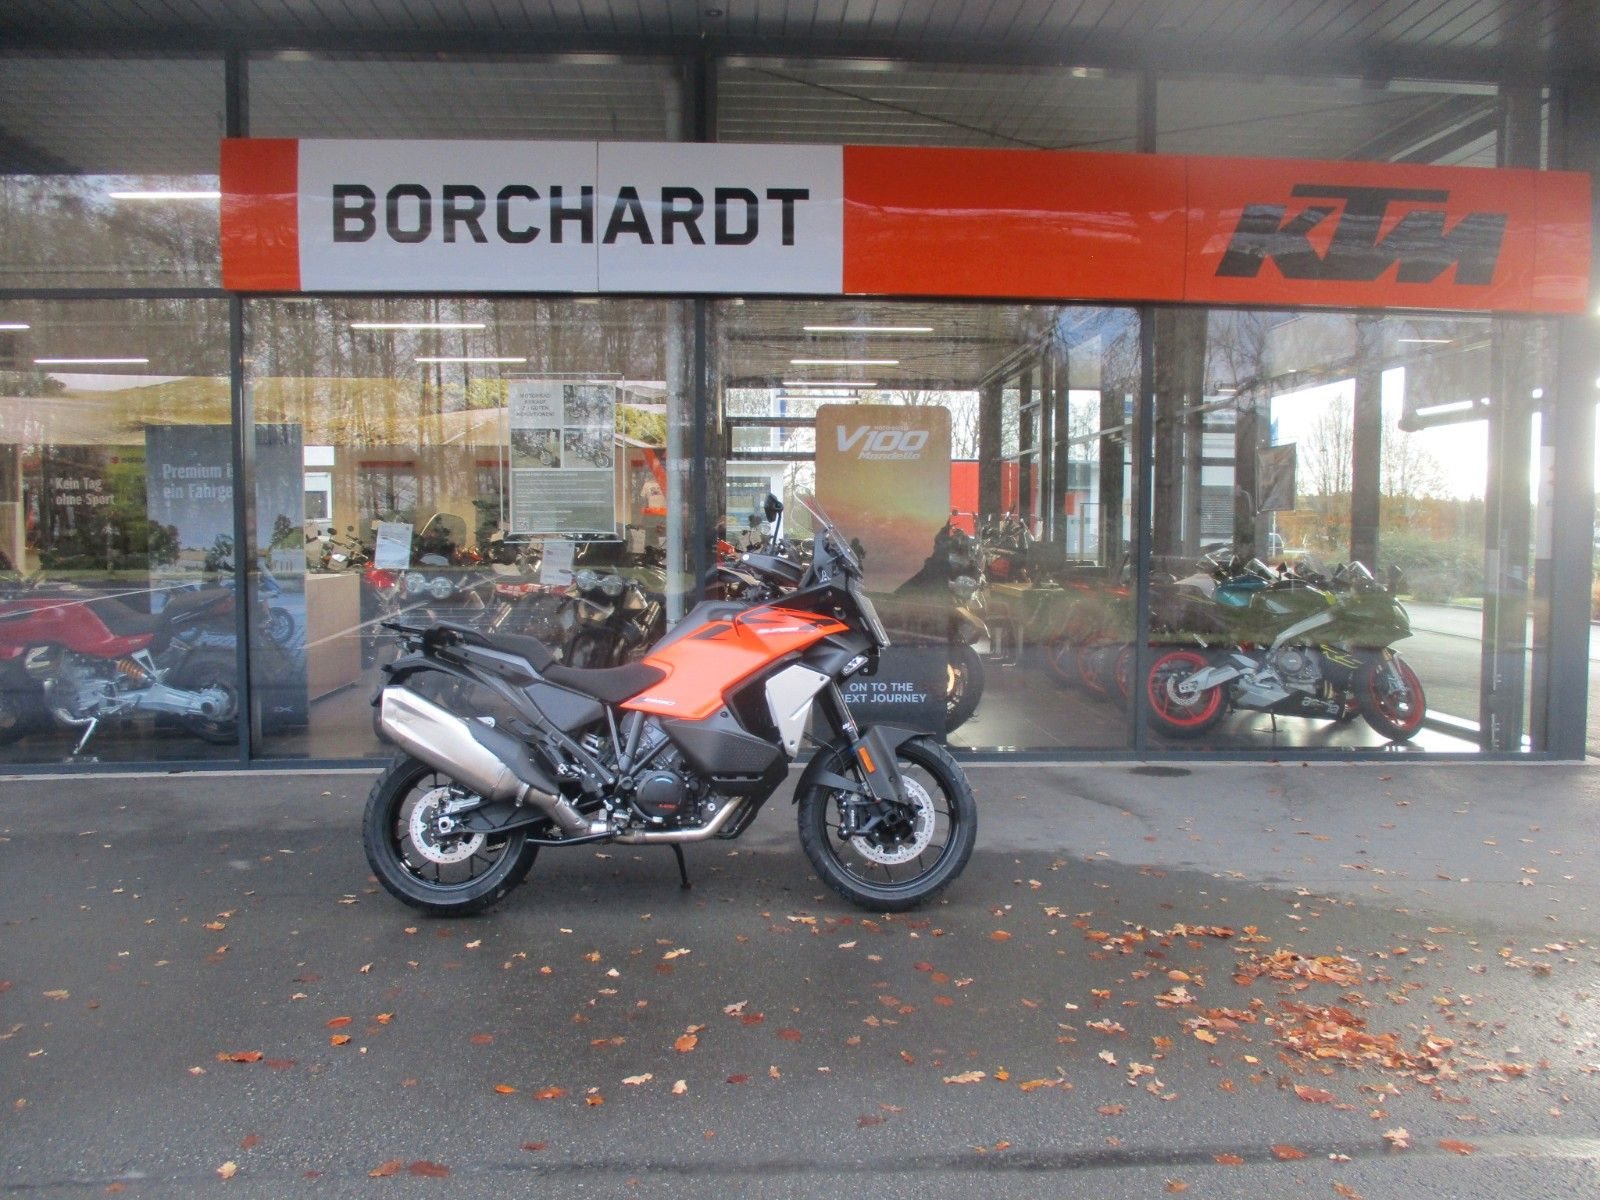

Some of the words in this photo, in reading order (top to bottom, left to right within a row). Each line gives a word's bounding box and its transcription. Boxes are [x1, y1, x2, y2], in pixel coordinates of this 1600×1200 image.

[332, 183, 810, 247] BORCHARDT
[1214, 183, 1509, 286] KTM
[836, 424, 929, 453] V100
[162, 463, 222, 479] Premium
[55, 477, 80, 490] Kein
[83, 477, 103, 492] Tag
[163, 483, 184, 499] ein
[56, 493, 82, 505] ohne
[86, 493, 116, 507] Sport
[849, 682, 867, 692] ON
[871, 682, 887, 692] TO
[890, 682, 914, 692] THE
[870, 693, 927, 703] JOURNEY
